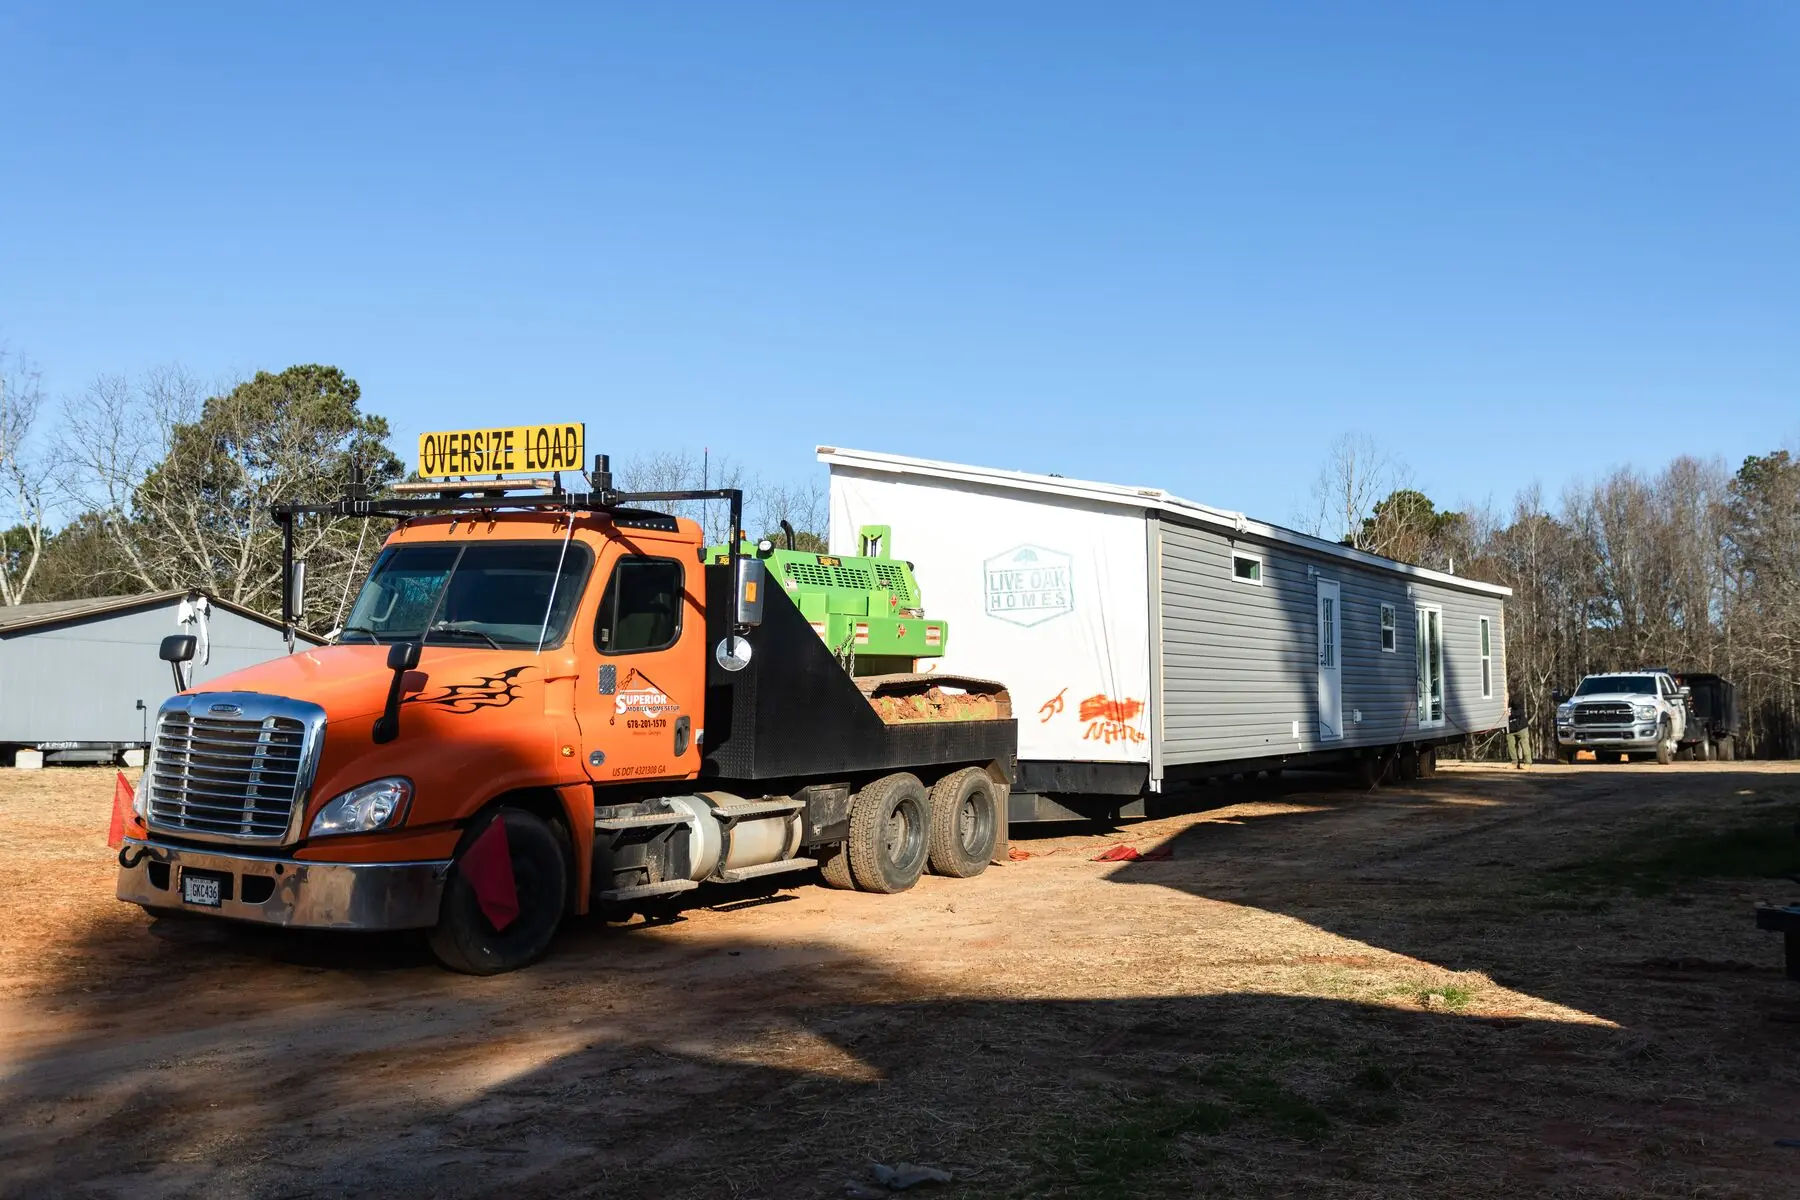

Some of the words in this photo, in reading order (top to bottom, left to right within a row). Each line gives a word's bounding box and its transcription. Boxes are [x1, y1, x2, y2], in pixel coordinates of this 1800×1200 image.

[424, 431, 514, 474] OVERSIZE
[526, 427, 577, 470] LOAD
[990, 572, 1024, 591] LIVE
[1030, 570, 1066, 589] OAK
[991, 591, 1066, 609] HOMES
[615, 694, 667, 714] SUPERIOR
[627, 719, 667, 729] 678-201-1570
[612, 767, 621, 777] US
[621, 766, 634, 776] DOT
[657, 764, 666, 774] GA
[192, 884, 217, 898] GKC436
